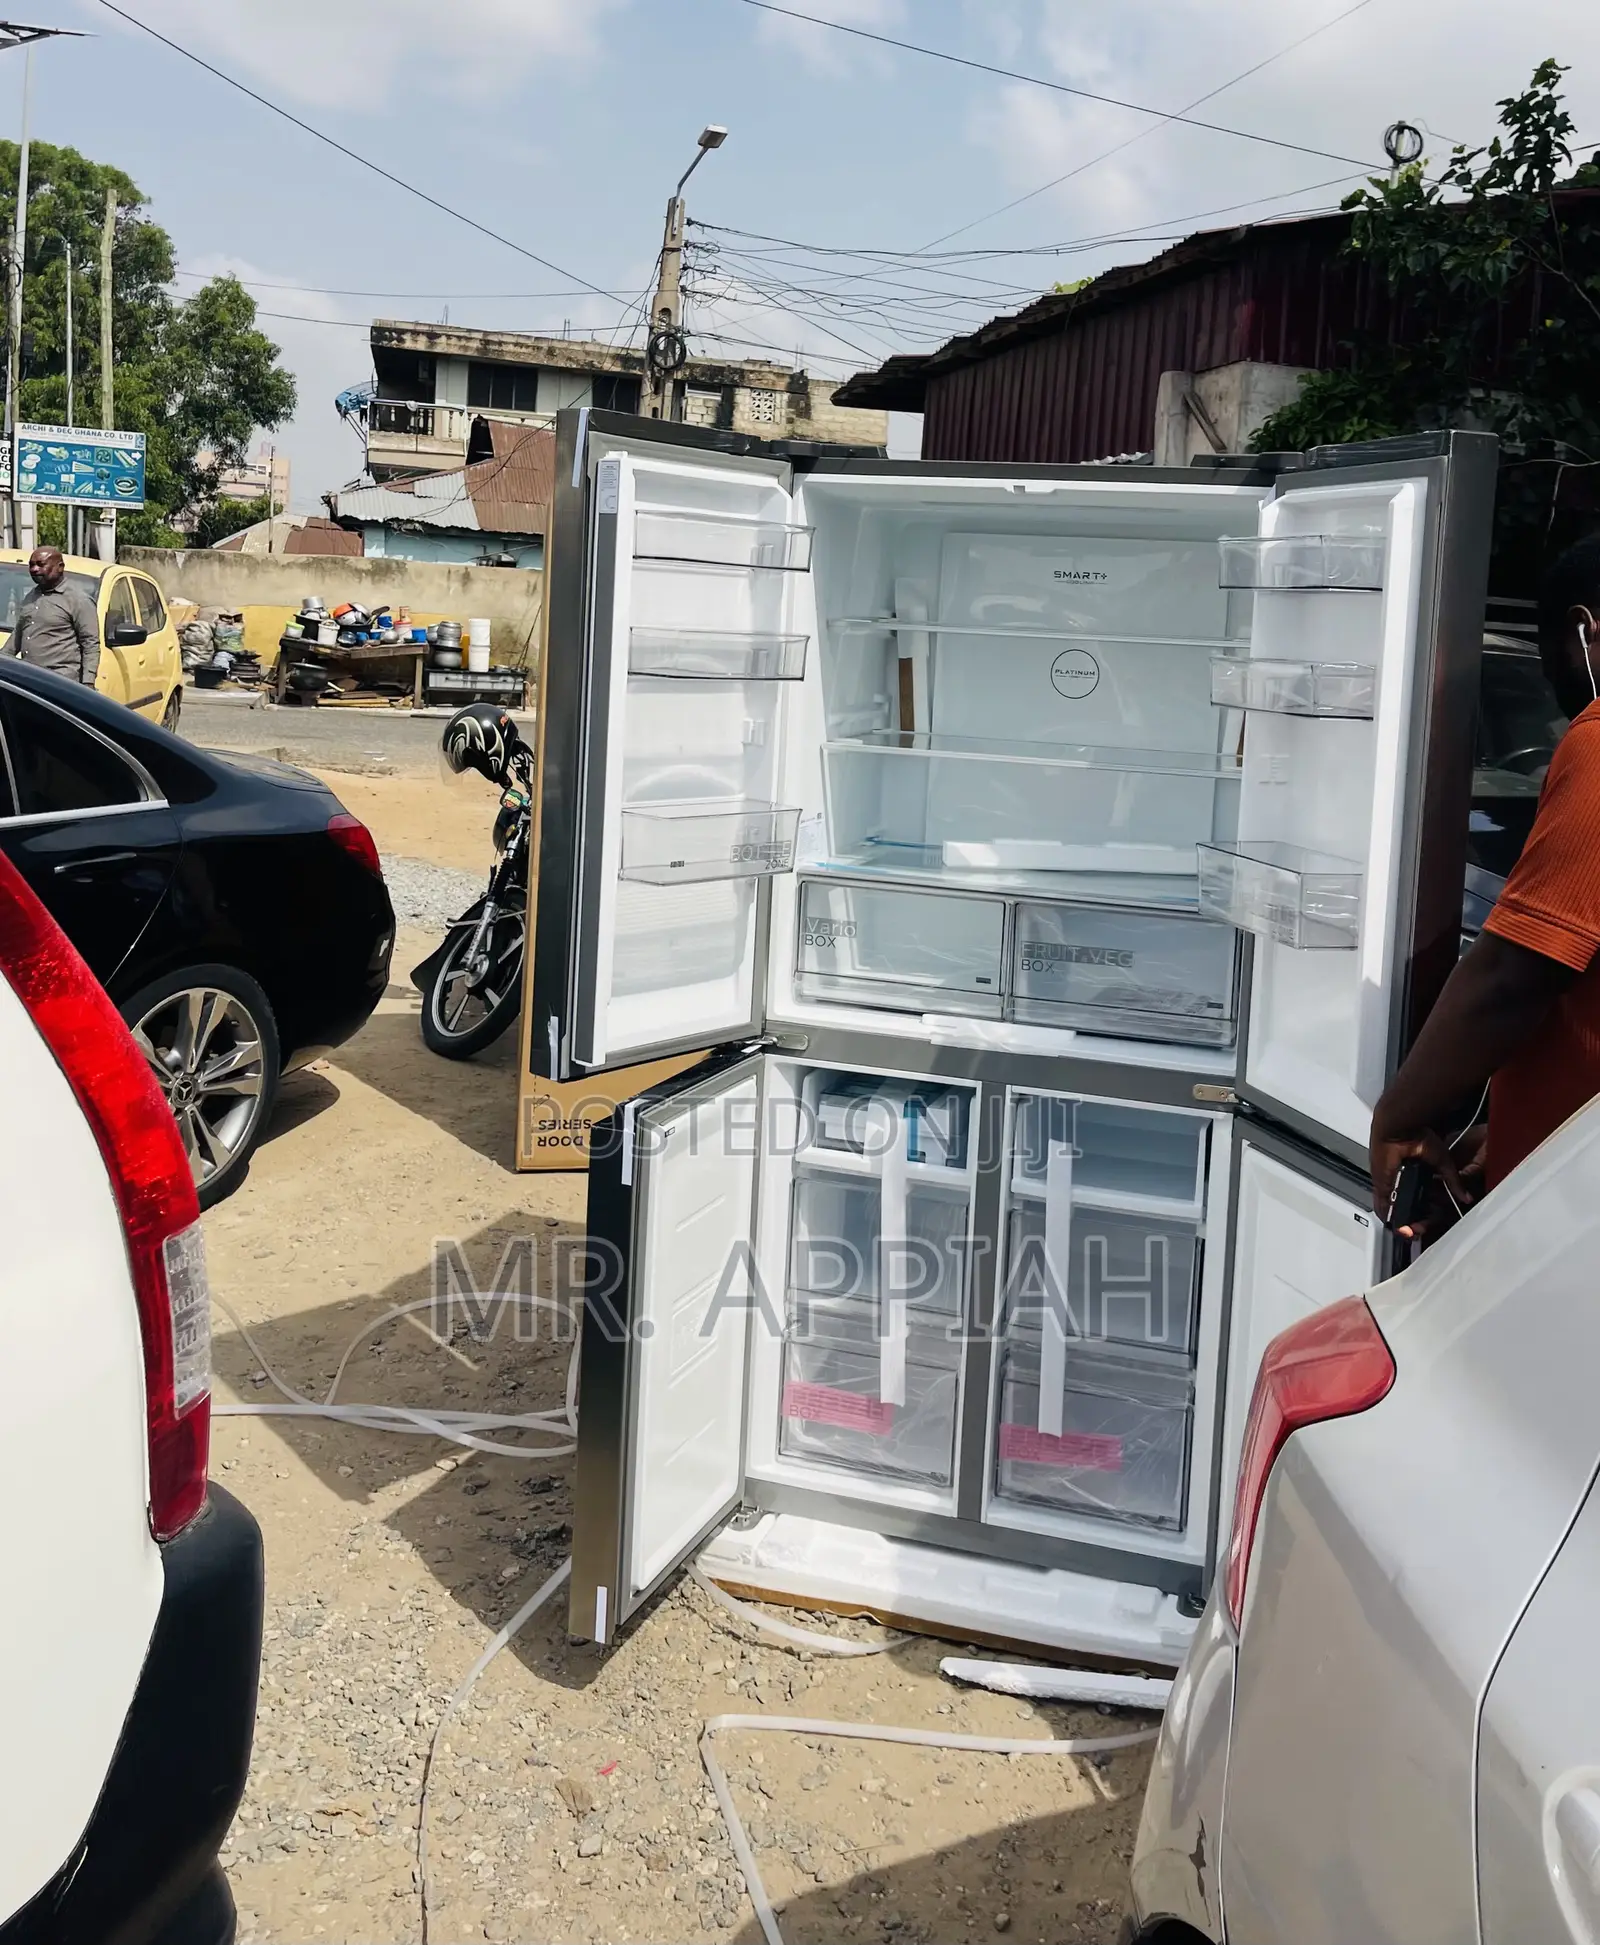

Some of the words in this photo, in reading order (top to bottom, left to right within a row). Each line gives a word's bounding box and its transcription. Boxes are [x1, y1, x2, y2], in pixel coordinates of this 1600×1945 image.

[21, 423, 46, 432] ARCHI
[74, 429, 102, 437] GHANA
[1055, 668, 1096, 676] PLATINUM
[765, 859, 789, 870] ZONE
[806, 917, 856, 938] Vario
[805, 934, 837, 948] BOX
[1021, 958, 1055, 974] BOX
[538, 1118, 592, 1131] SERIES
[537, 1135, 584, 1148] DOOR
